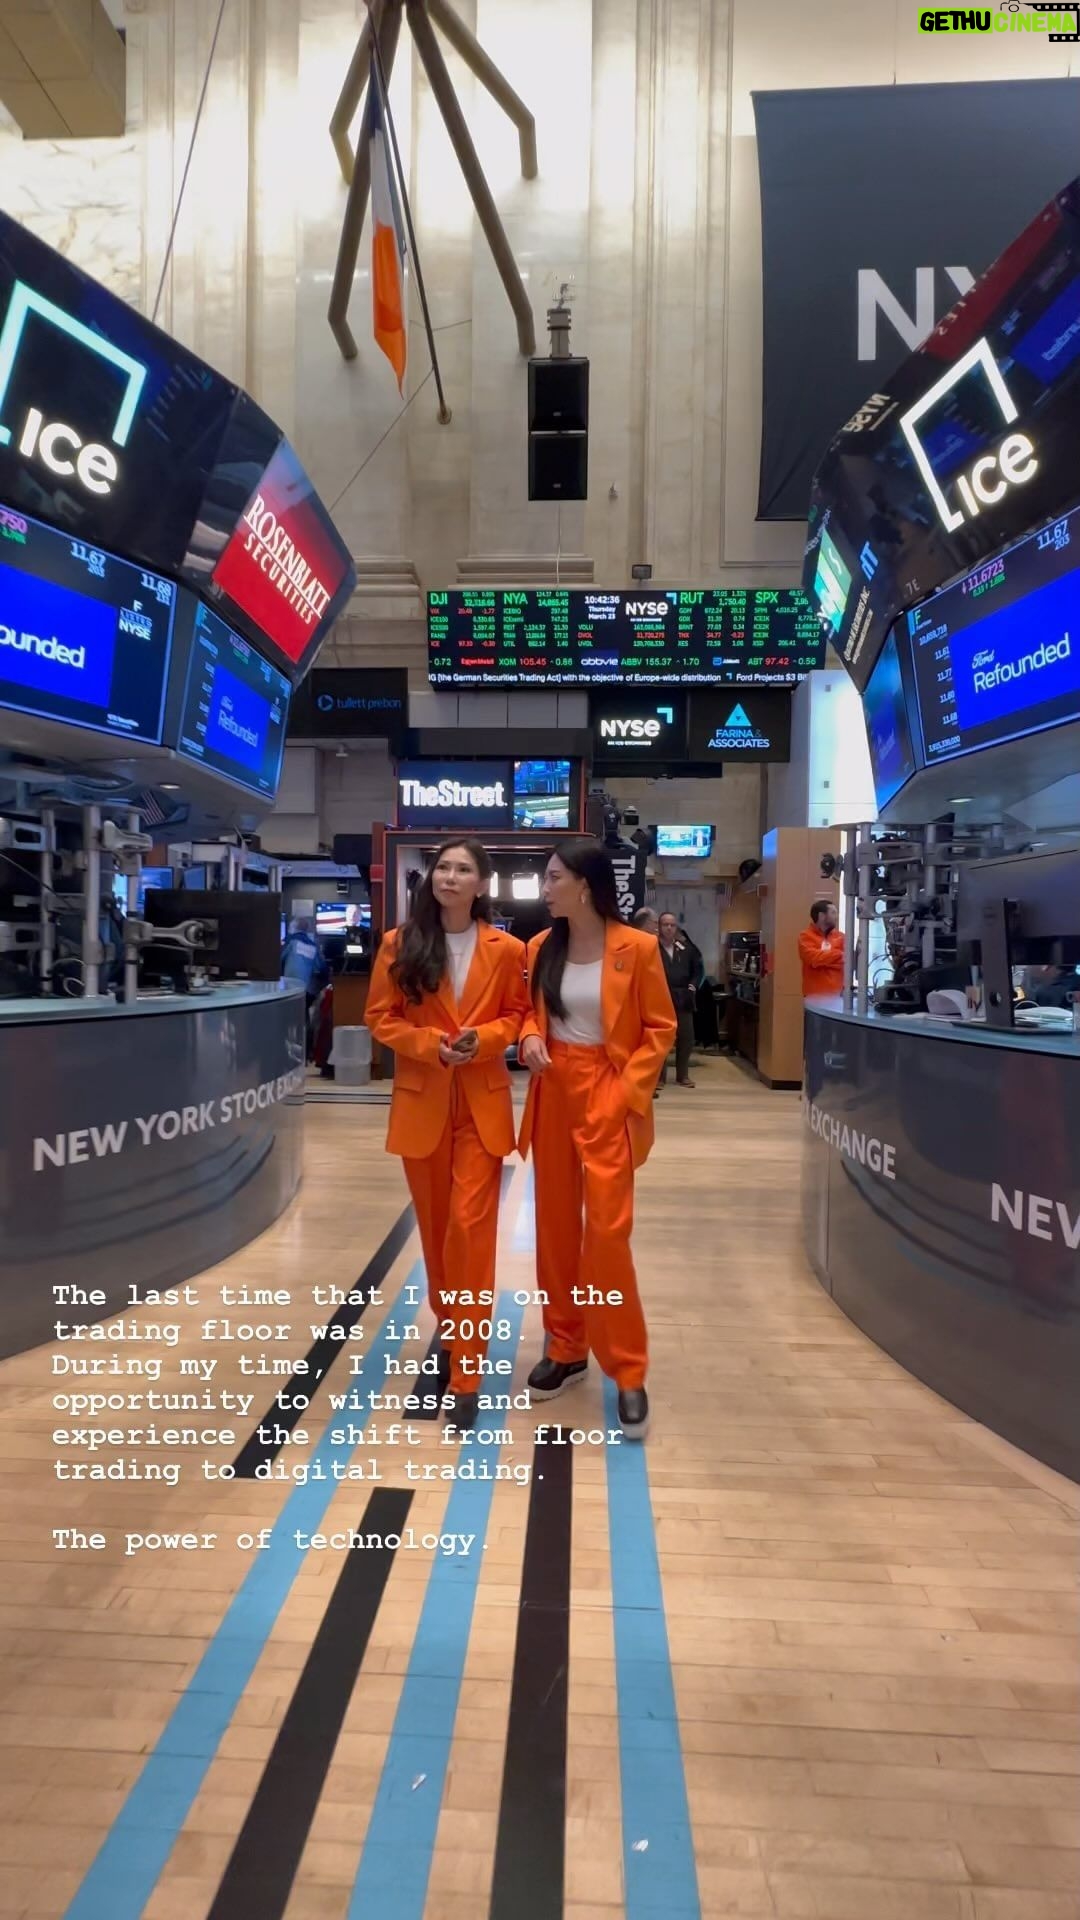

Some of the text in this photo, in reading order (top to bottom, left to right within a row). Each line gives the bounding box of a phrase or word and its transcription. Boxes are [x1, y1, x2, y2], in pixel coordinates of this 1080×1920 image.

[1036, 519, 1069, 550] 11.67
[70, 542, 107, 567] 11.67
[246, 493, 331, 615] ROSENBLATT
[244, 533, 314, 624] SECURITIES
[429, 592, 448, 605] DJI
[503, 592, 528, 605] NYA
[584, 595, 620, 604] 10:42:36
[680, 592, 705, 604] RUT
[755, 592, 779, 604] SPX
[118, 619, 152, 641] NYSE
[434, 658, 452, 666] 0.72
[499, 658, 516, 666] XOM
[520, 658, 547, 666] 105.45
[581, 658, 618, 666] abbvie
[621, 658, 642, 666] ABBV
[645, 658, 672, 666] 155.37
[683, 658, 700, 666] 1.70
[971, 648, 995, 670] Ford
[973, 632, 1071, 694] Refounded
[453, 673, 481, 681] German
[483, 673, 518, 681] Securities
[519, 673, 545, 683] Trading
[547, 673, 561, 682] Act]
[562, 673, 577, 681] with
[579, 673, 590, 681] the
[592, 673, 623, 683] objective
[625, 673, 633, 681] of
[634, 674, 680, 683] Europe-wide
[681, 673, 721, 681] distribution
[754, 674, 784, 682] Projects
[786, 673, 796, 681] $3
[716, 729, 763, 738] FARINA &
[708, 738, 770, 748] ASSOCIATES
[33, 1121, 128, 1171] NEW
[134, 1100, 216, 1146] YORK
[219, 1086, 276, 1123] STOCK
[811, 1103, 897, 1180] EXCHANGE
